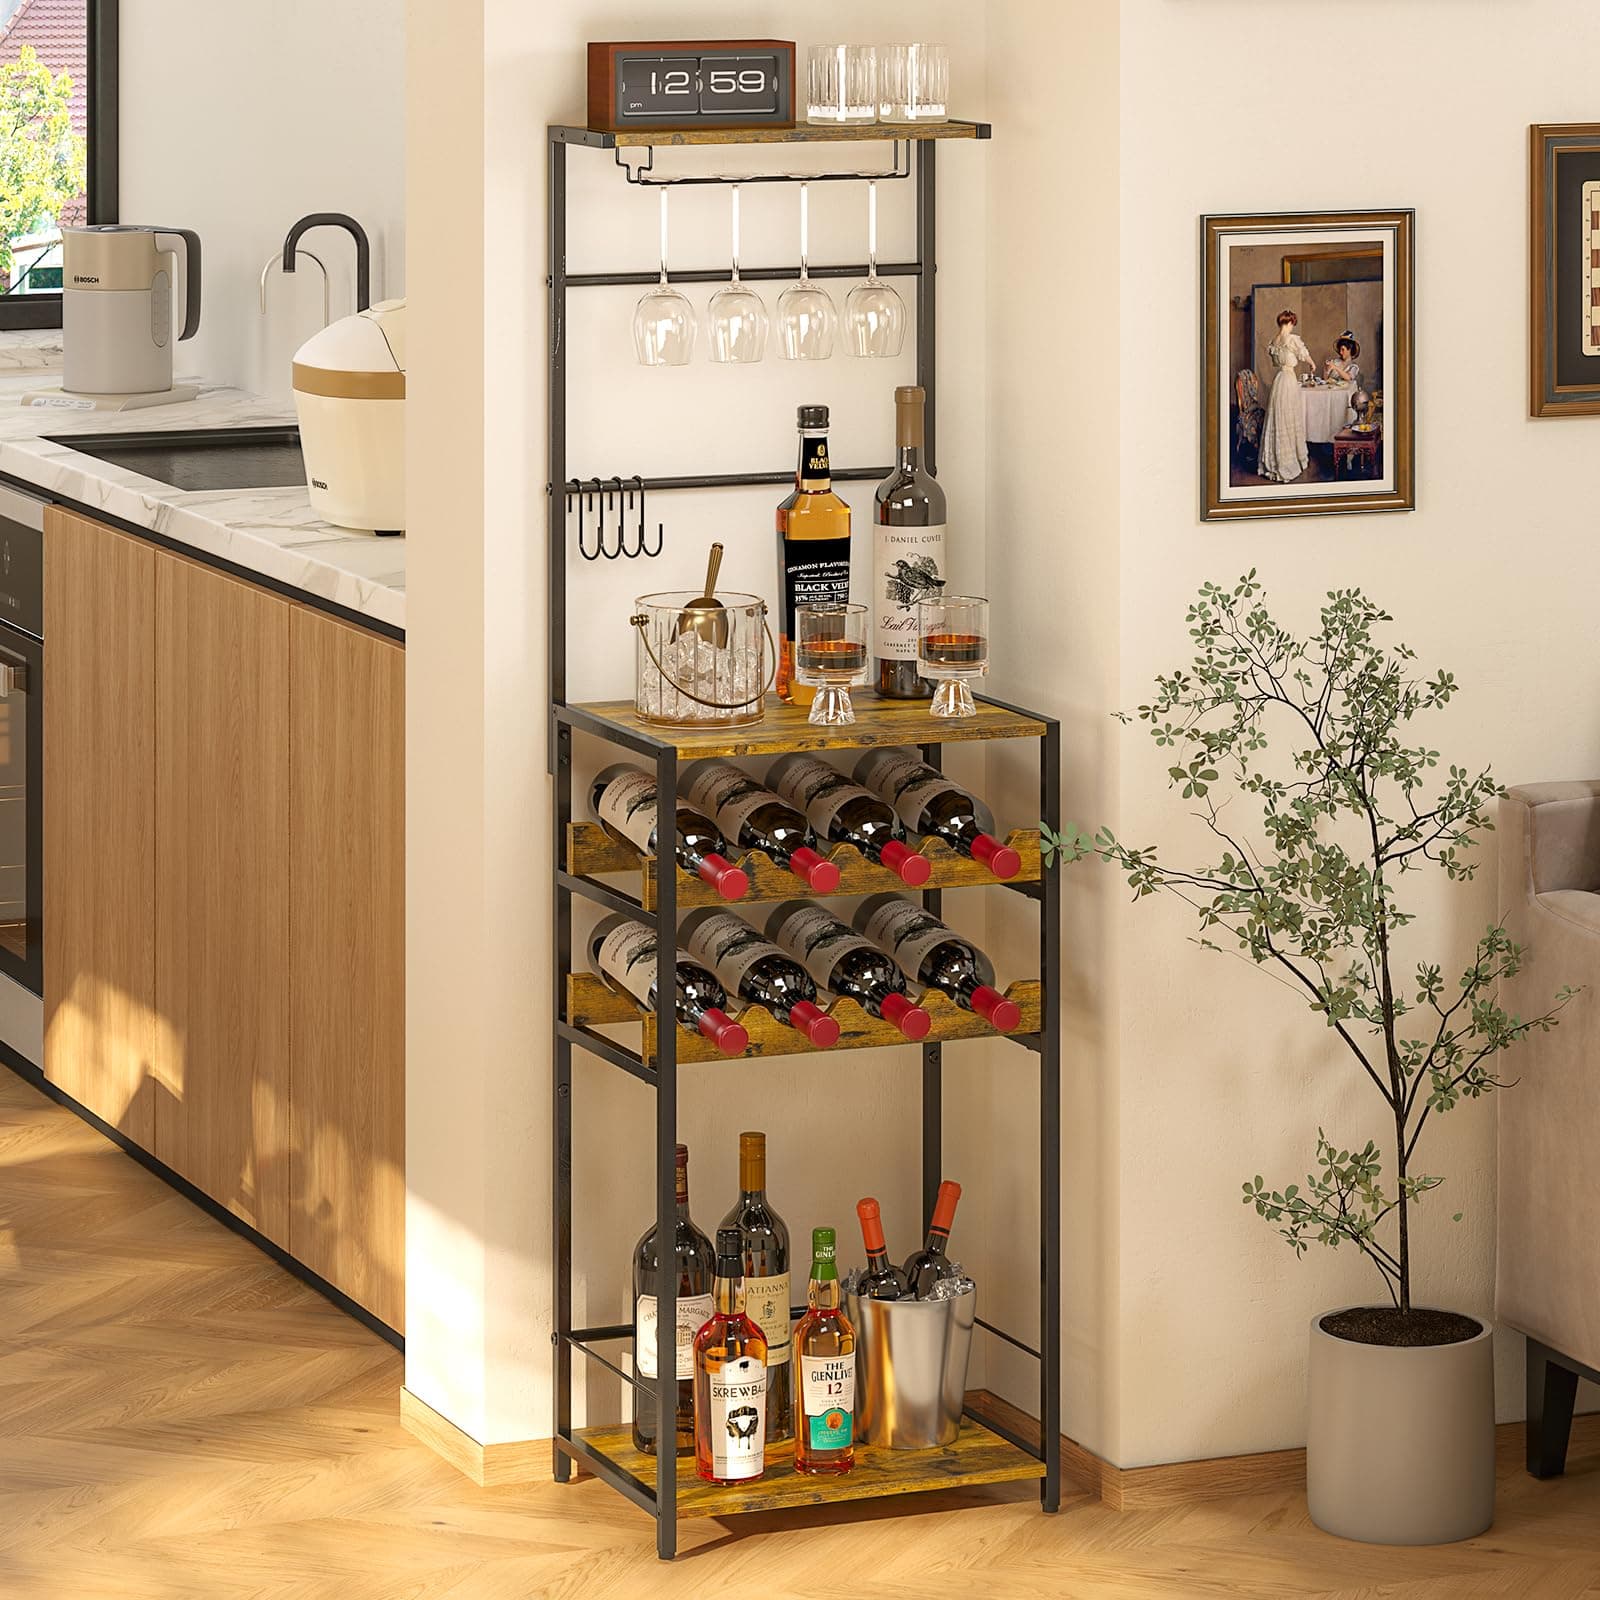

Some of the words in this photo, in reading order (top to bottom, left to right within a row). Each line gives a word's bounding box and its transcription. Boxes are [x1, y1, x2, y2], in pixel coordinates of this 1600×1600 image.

[651, 71, 690, 95] 12
[710, 70, 765, 94] 59
[80, 276, 99, 284] BOSCH
[890, 535, 919, 544] DANIEL
[794, 583, 829, 592] BLACK
[824, 1361, 845, 1371] THE
[828, 1382, 843, 1395] 12
